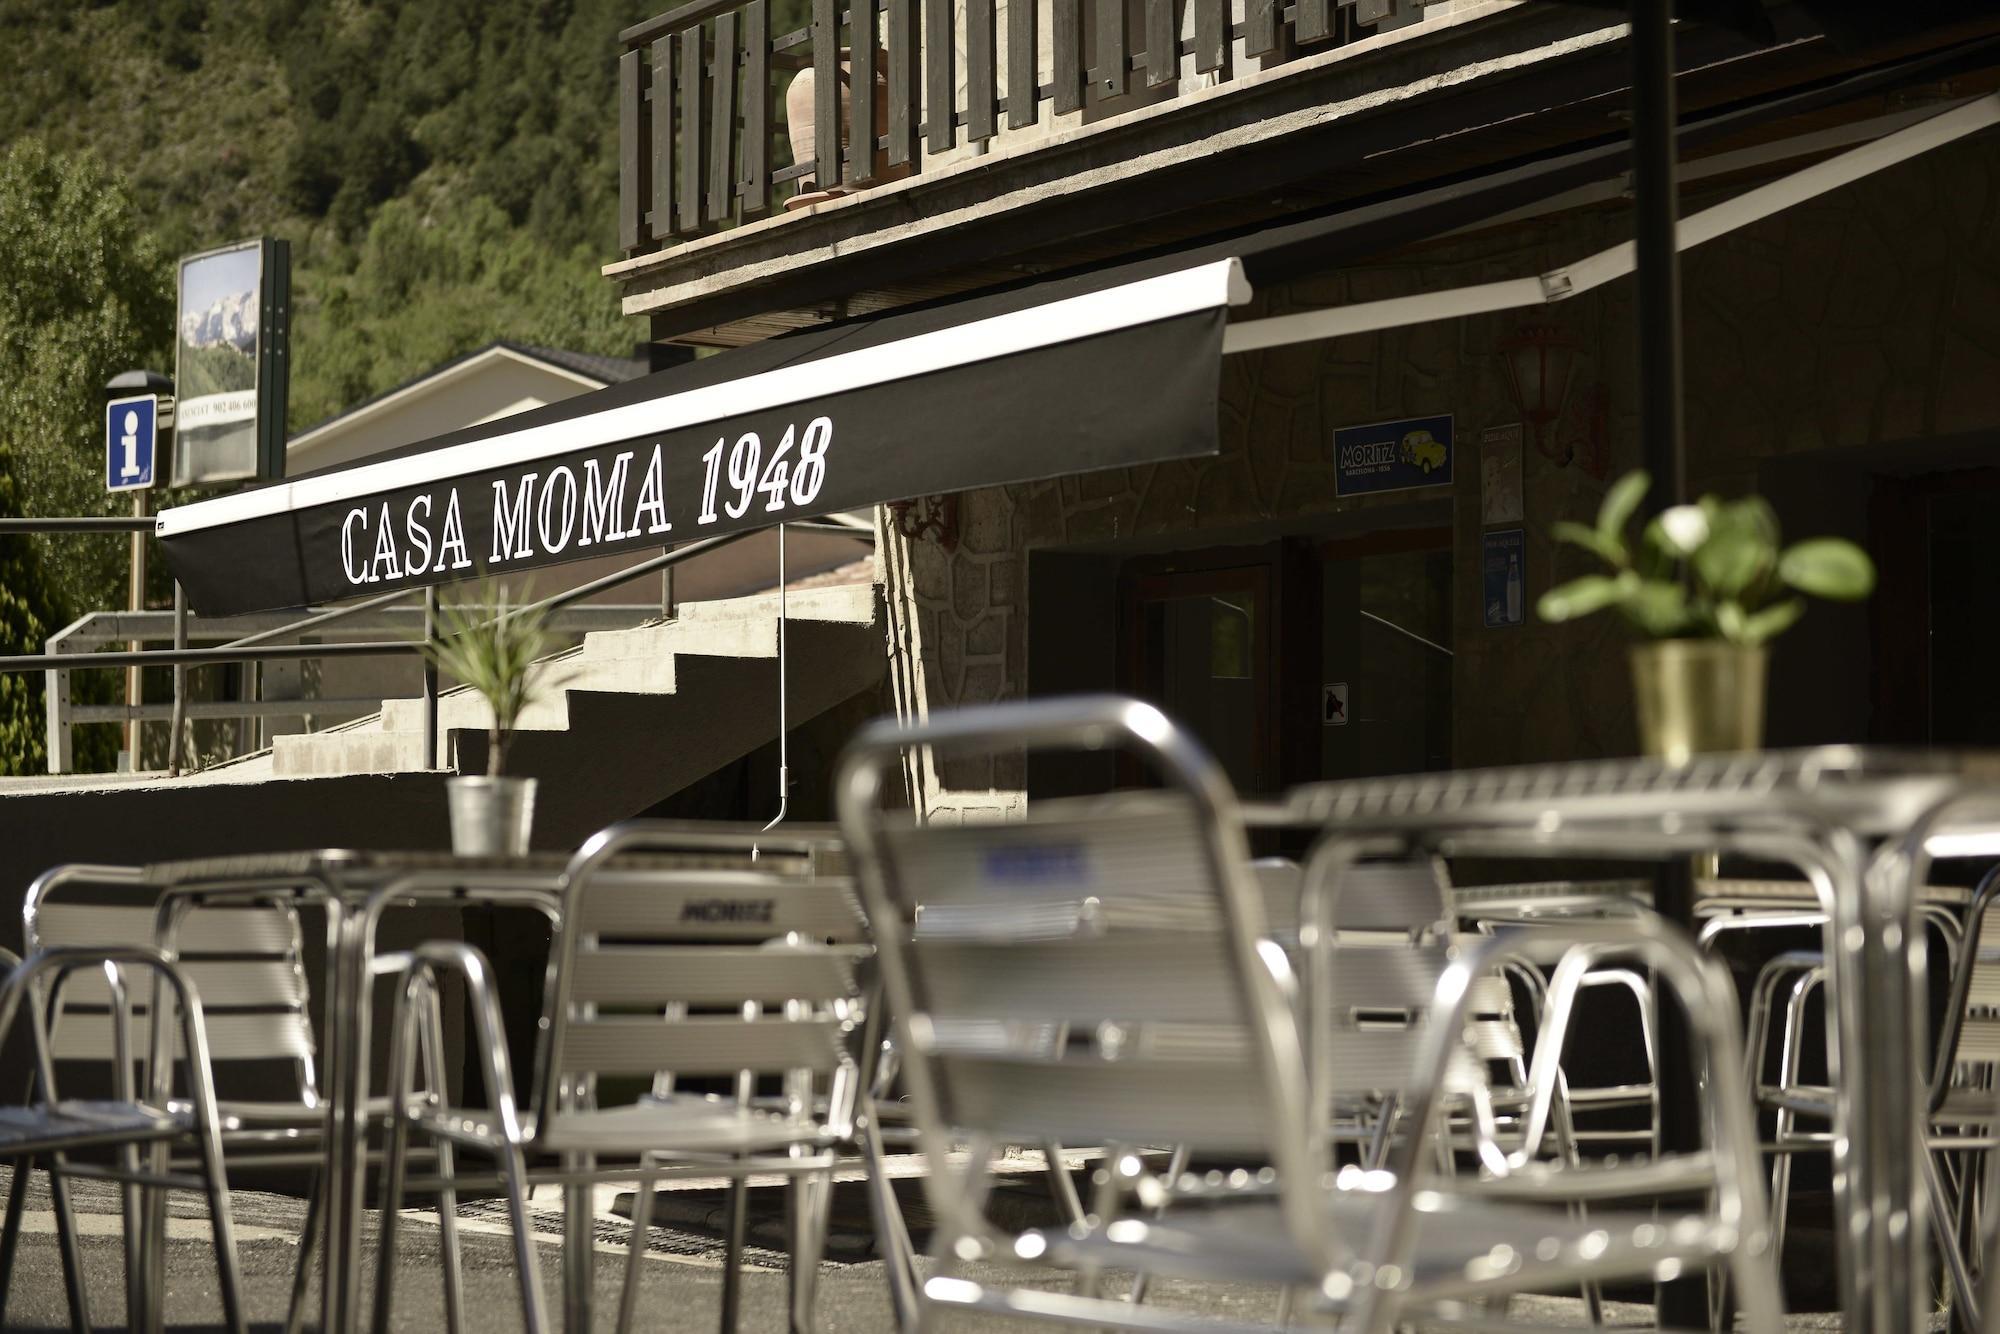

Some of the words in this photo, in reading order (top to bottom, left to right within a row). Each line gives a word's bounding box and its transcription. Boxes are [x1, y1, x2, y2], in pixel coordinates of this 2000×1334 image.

[1340, 441, 1396, 469] MORITZ
[1346, 466, 1375, 476] BARCELONA
[342, 488, 471, 585] CASA
[489, 443, 672, 563] MOMA
[698, 416, 833, 525] 1948
